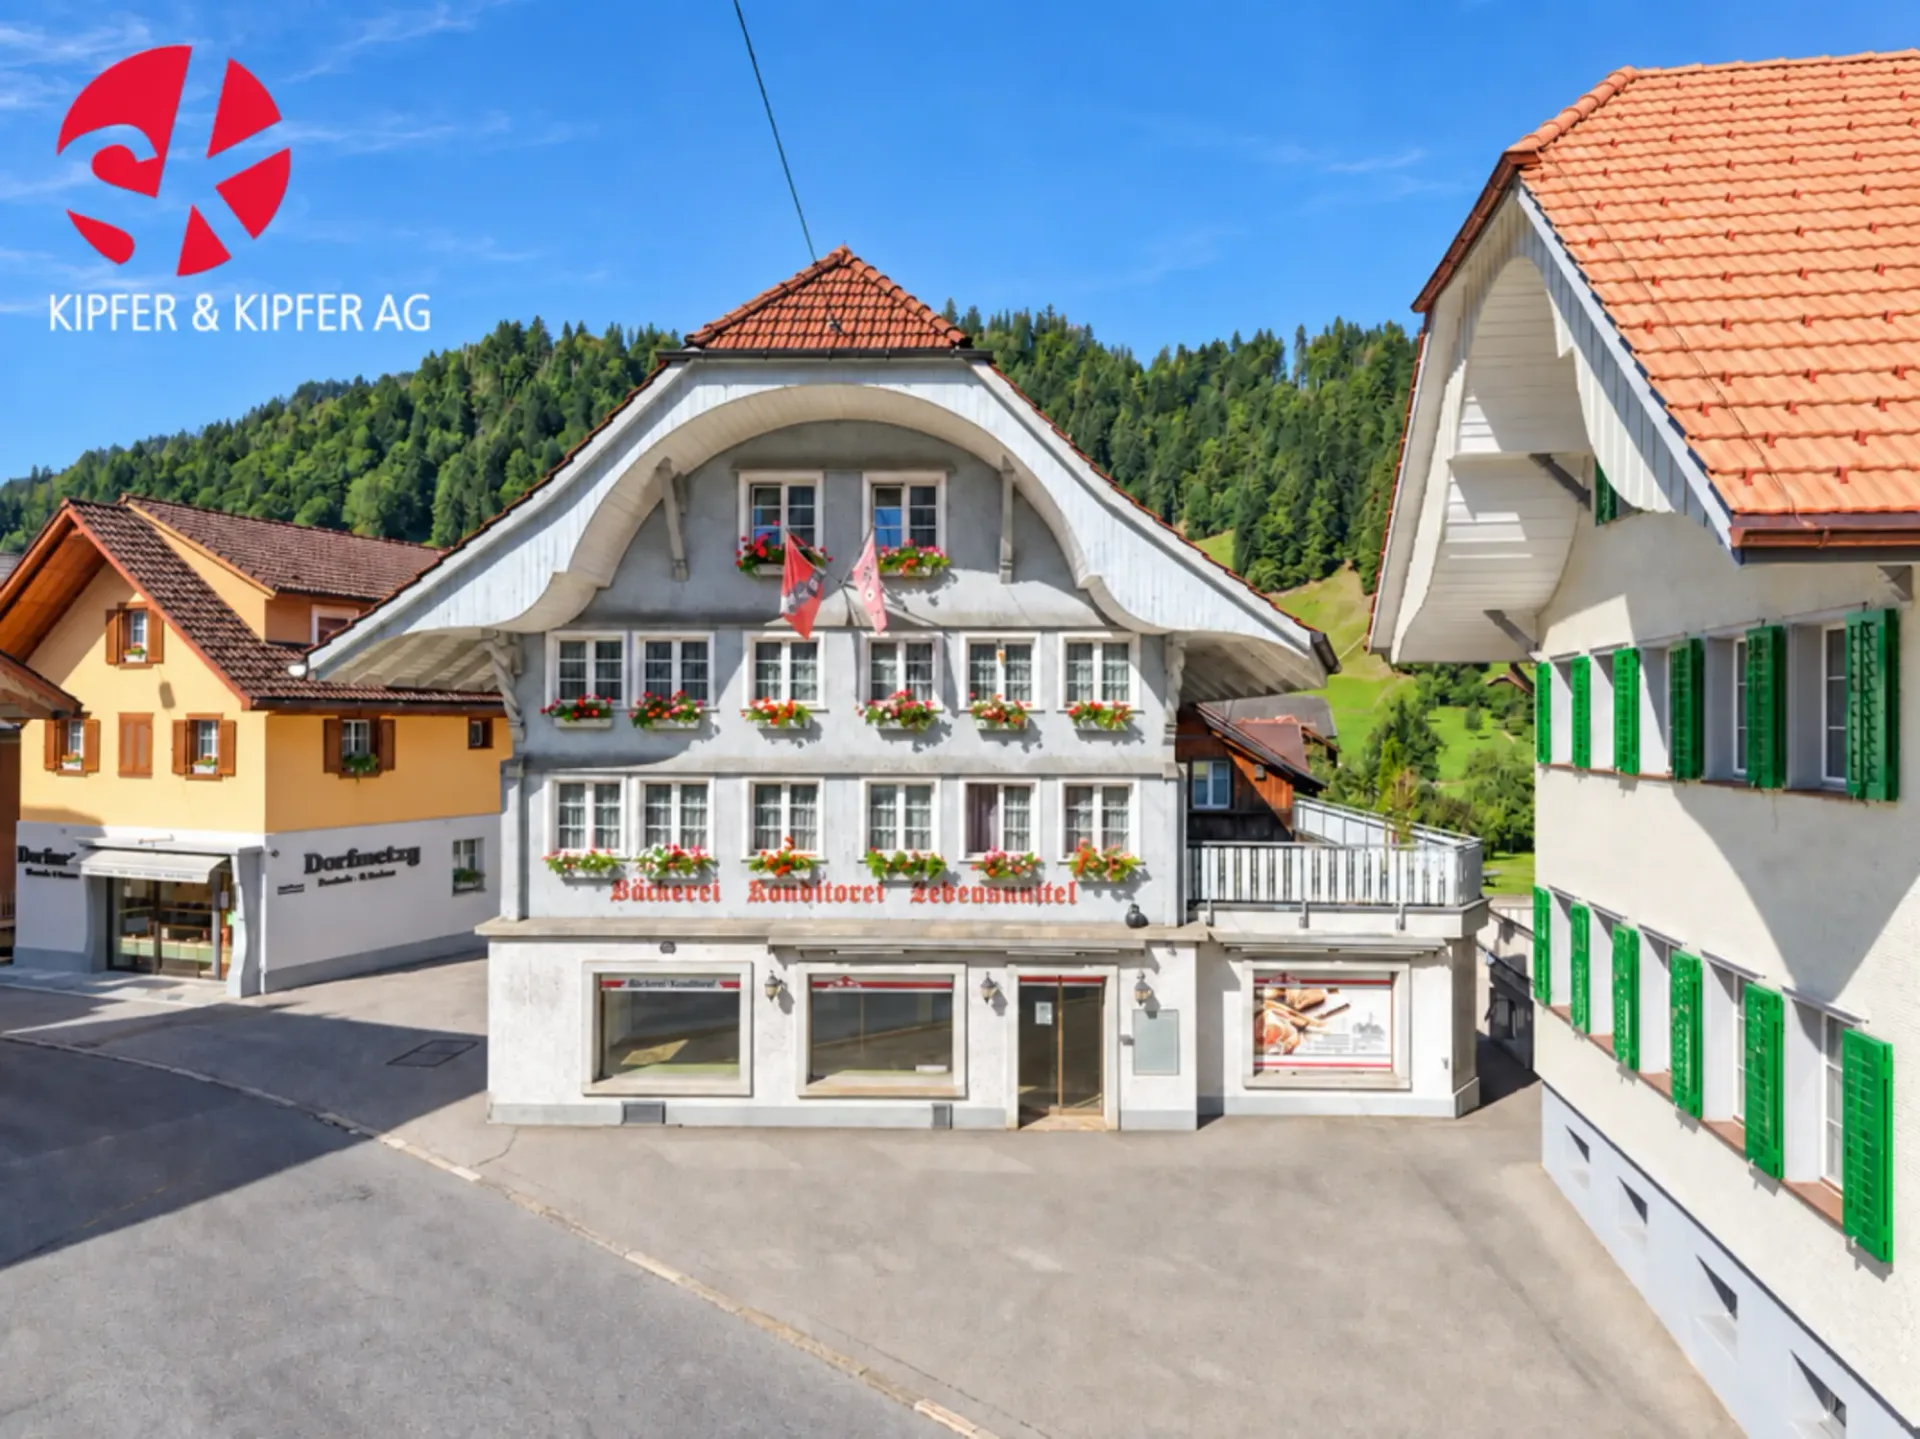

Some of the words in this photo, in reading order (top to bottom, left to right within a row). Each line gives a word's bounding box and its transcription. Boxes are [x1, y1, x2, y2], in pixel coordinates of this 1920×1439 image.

[303, 845, 421, 874] Dorfmetzg
[610, 877, 721, 903] Bäckerei
[746, 876, 885, 904] Konditorei
